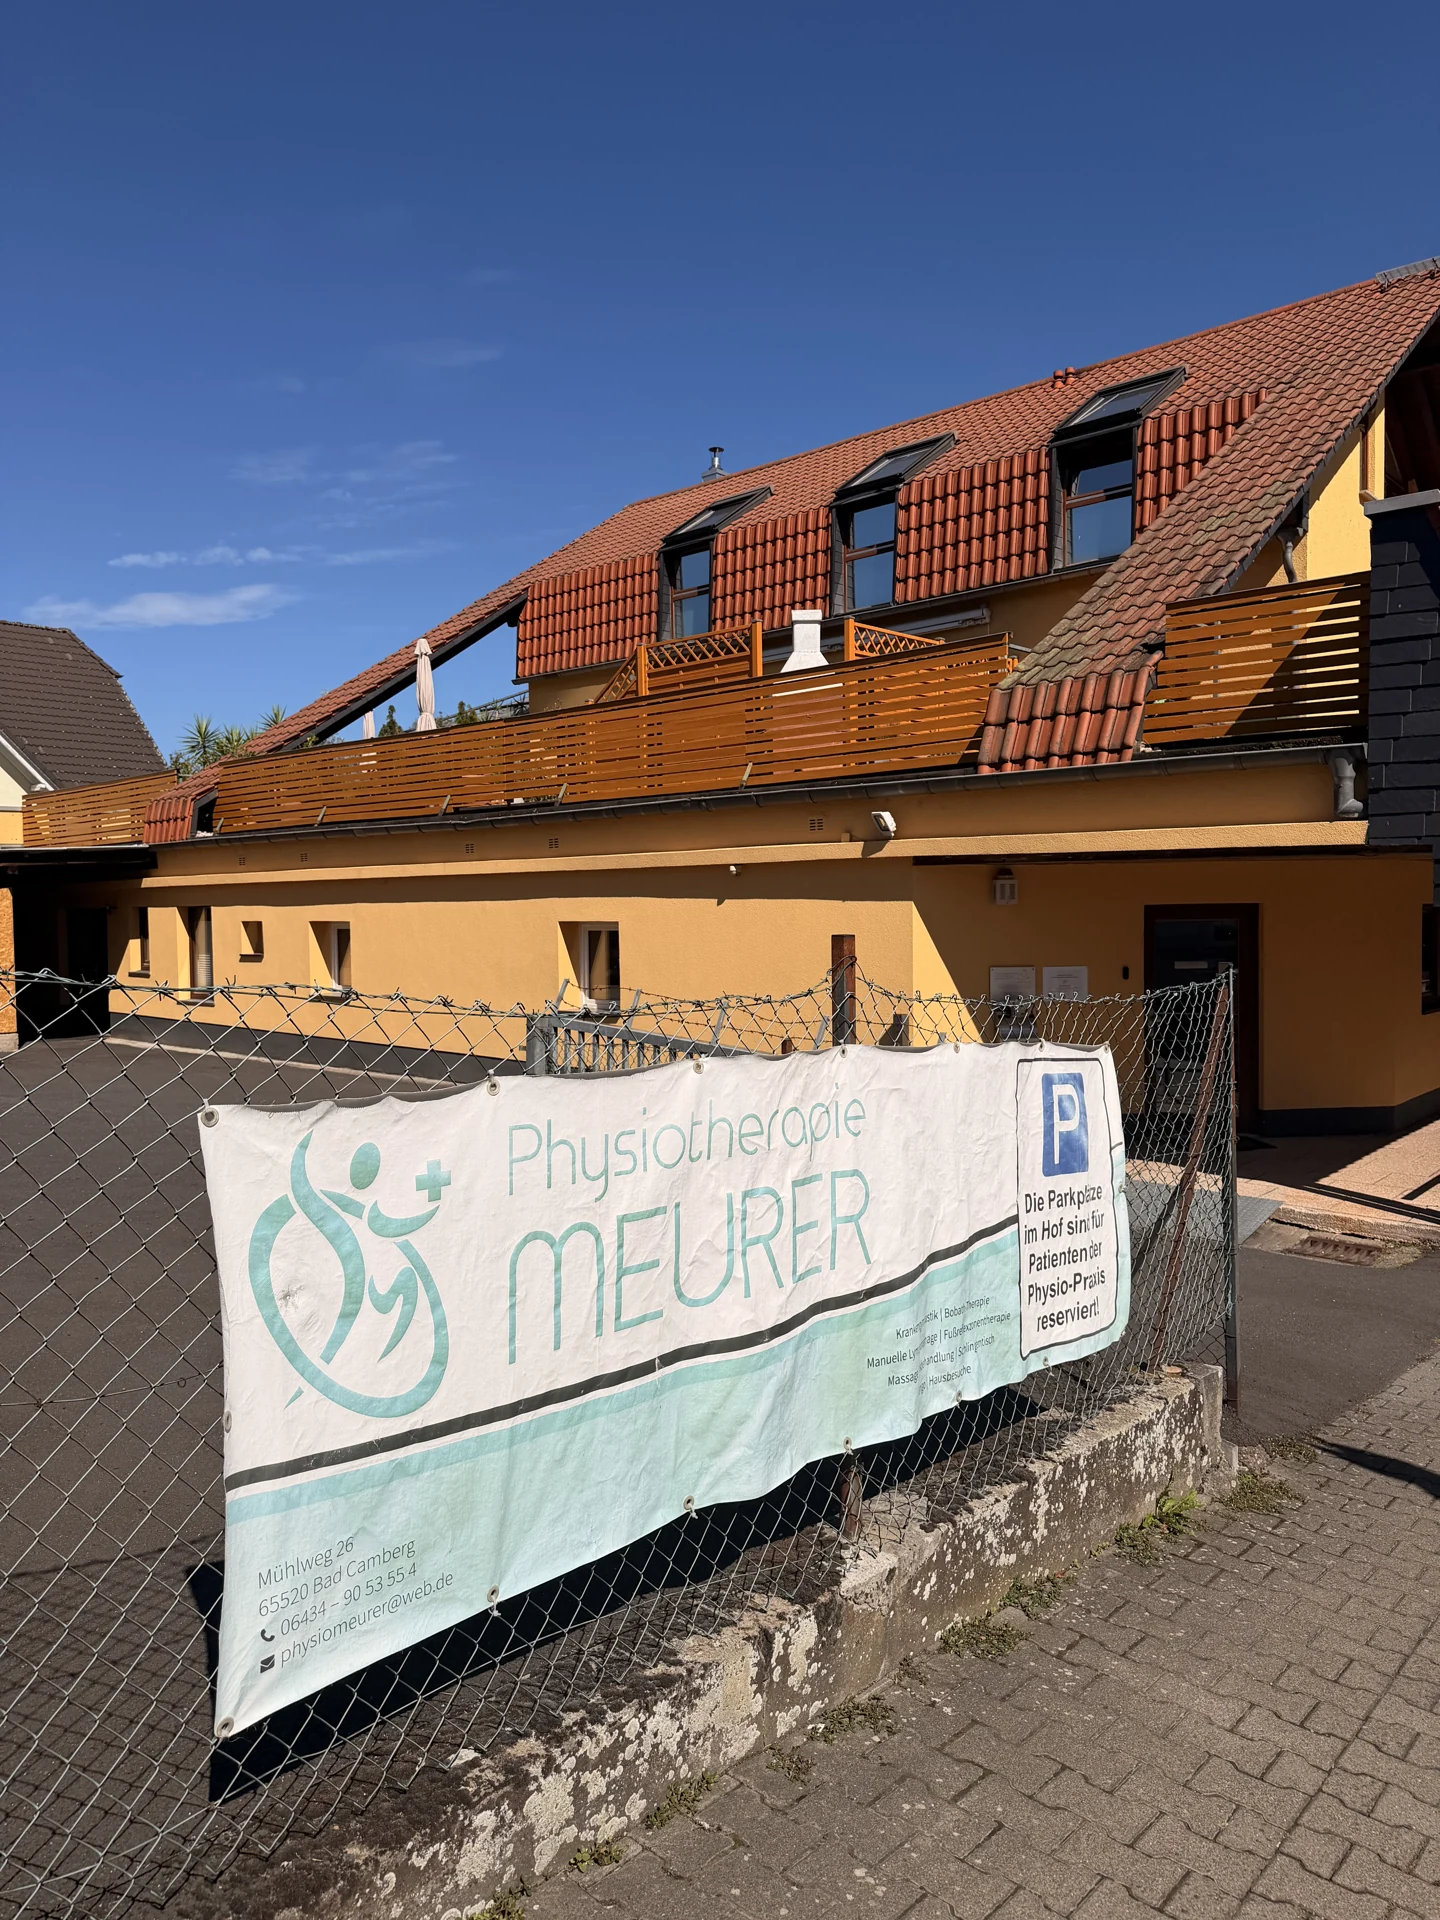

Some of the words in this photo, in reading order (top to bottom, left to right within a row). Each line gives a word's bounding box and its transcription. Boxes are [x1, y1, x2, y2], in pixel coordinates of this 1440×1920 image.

[508, 1083, 866, 1202] Physiotherapie
[1052, 1084, 1080, 1165] P
[1024, 1192, 1045, 1214] Die
[1024, 1224, 1038, 1245] im
[1041, 1216, 1064, 1240] Hof
[1091, 1208, 1105, 1230] für
[508, 1167, 872, 1365] MEURER
[1028, 1246, 1088, 1275] Patienten
[1089, 1239, 1103, 1260] der
[1027, 1266, 1106, 1306] Physio-Praxis
[1036, 1295, 1100, 1333] reserviert!
[866, 1350, 908, 1369] Manuelle
[928, 1364, 972, 1385] Hausbesuche
[258, 1548, 333, 1590] Mühlweg
[336, 1536, 354, 1558] 26
[259, 1583, 309, 1617] 65520
[313, 1565, 342, 1595] Bad
[346, 1540, 416, 1578] Camberg
[280, 1601, 327, 1636] 06434
[343, 1585, 361, 1606] 90
[365, 1576, 383, 1596] 53
[386, 1566, 405, 1587] 55
[407, 1562, 417, 1577] 4
[280, 1572, 454, 1669] physiomeurer@web.de
